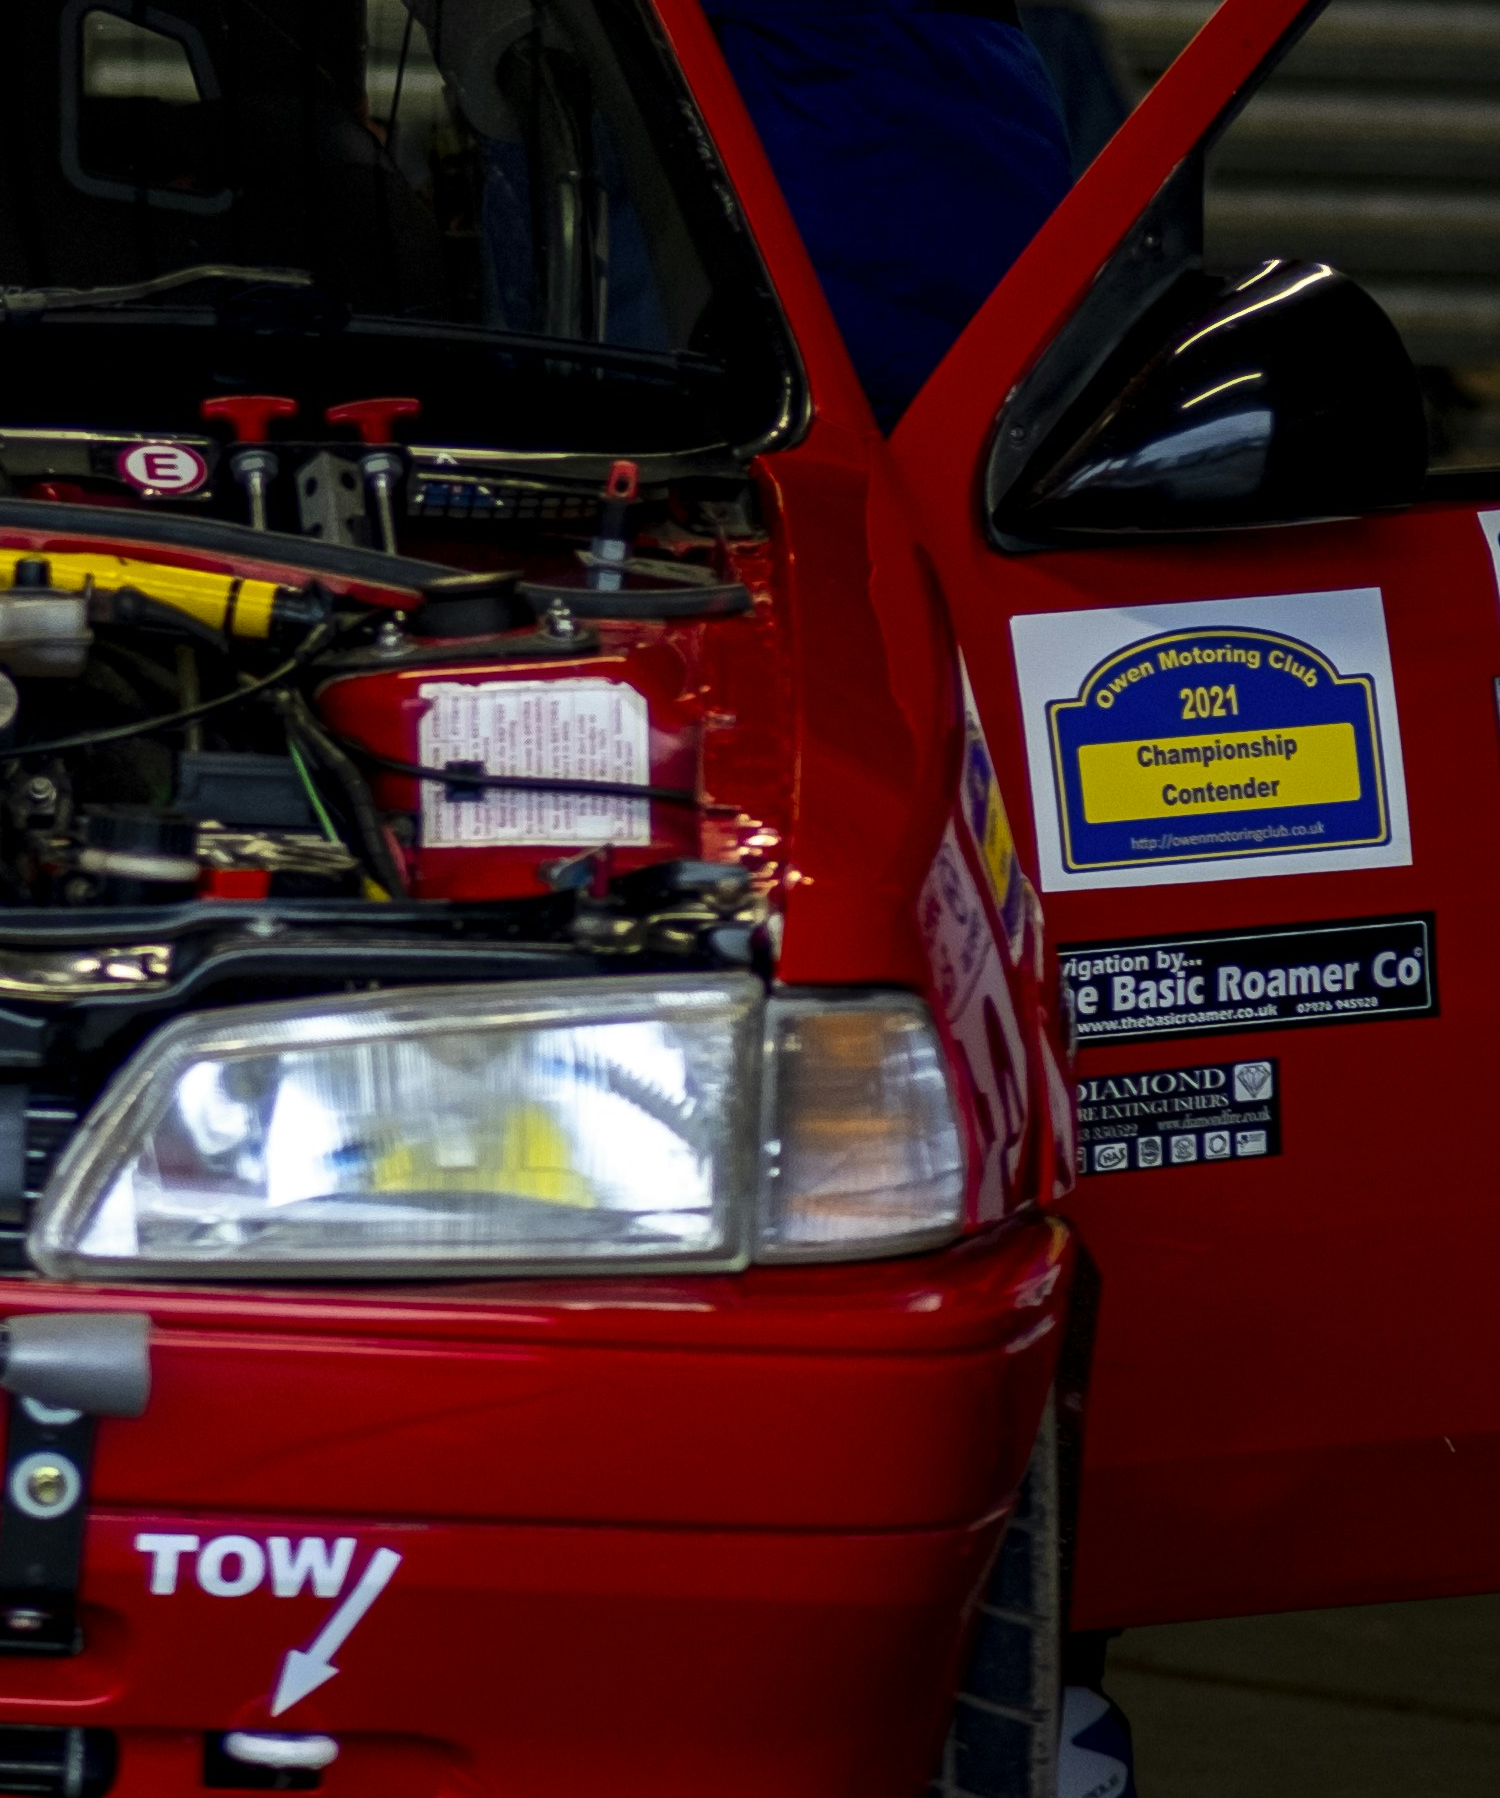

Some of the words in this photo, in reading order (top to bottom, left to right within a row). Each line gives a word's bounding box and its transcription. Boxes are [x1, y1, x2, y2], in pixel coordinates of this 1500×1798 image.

[144, 453, 182, 481] E
[1096, 660, 1154, 710] Owen
[1157, 644, 1261, 672] Motoring
[1268, 649, 1318, 688] Club
[1179, 684, 1239, 720] 2021
[1137, 734, 1297, 768] Championship
[1162, 777, 1280, 806] Contender
[1130, 820, 1325, 851] http://owenmotoringclub.co.uk
[1111, 971, 1205, 1013] Basic
[1217, 961, 1360, 1003] Roamer
[1100, 1093, 1230, 1119] EXTINGUISHERS
[134, 1533, 358, 1598] TOW
